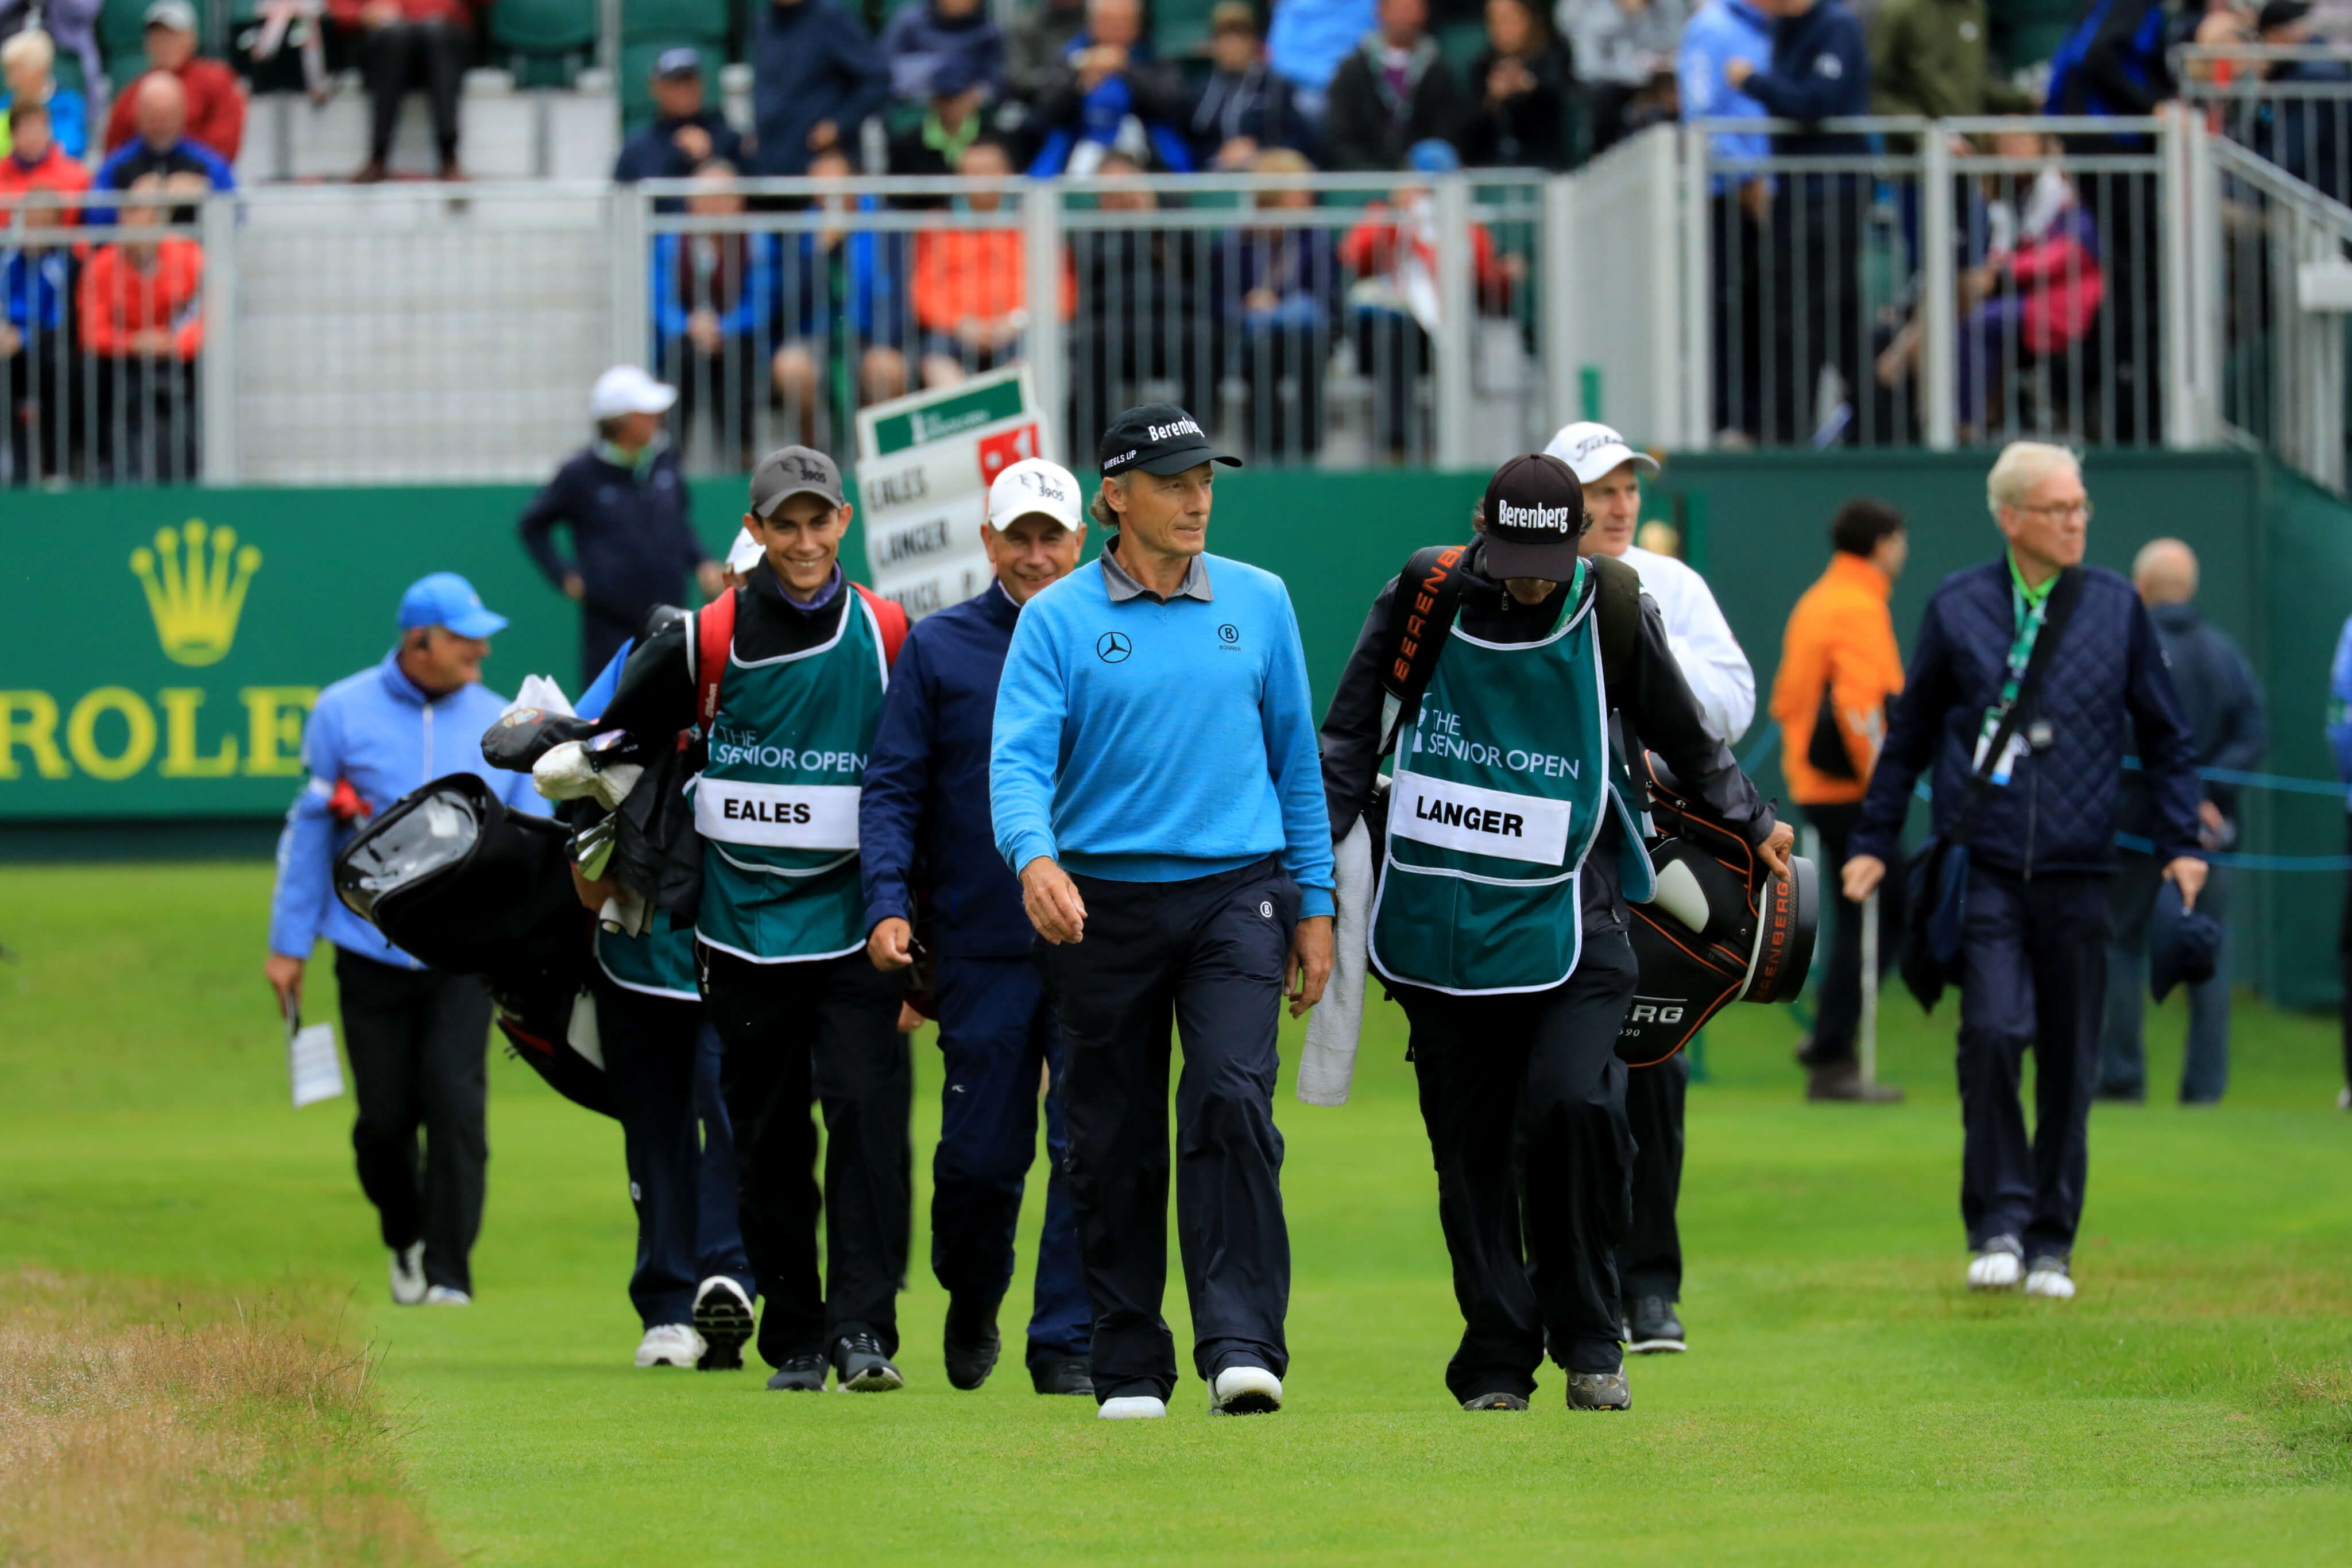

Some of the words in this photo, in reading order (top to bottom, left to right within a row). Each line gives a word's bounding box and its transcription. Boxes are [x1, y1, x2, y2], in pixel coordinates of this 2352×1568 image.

[1104, 454, 1125, 471] WHEELS
[1127, 450, 1137, 460] UP
[800, 470, 827, 484] 3905
[1038, 486, 1065, 501] 3905
[1499, 499, 1568, 534] Berenberg
[1433, 709, 1461, 735] THE
[719, 725, 757, 747] THE
[800, 750, 868, 772] OPEN
[1428, 733, 1503, 768] SENIOR
[1506, 749, 1579, 780] OPEN
[724, 798, 811, 824] EALES
[1416, 795, 1524, 837] LANGER
